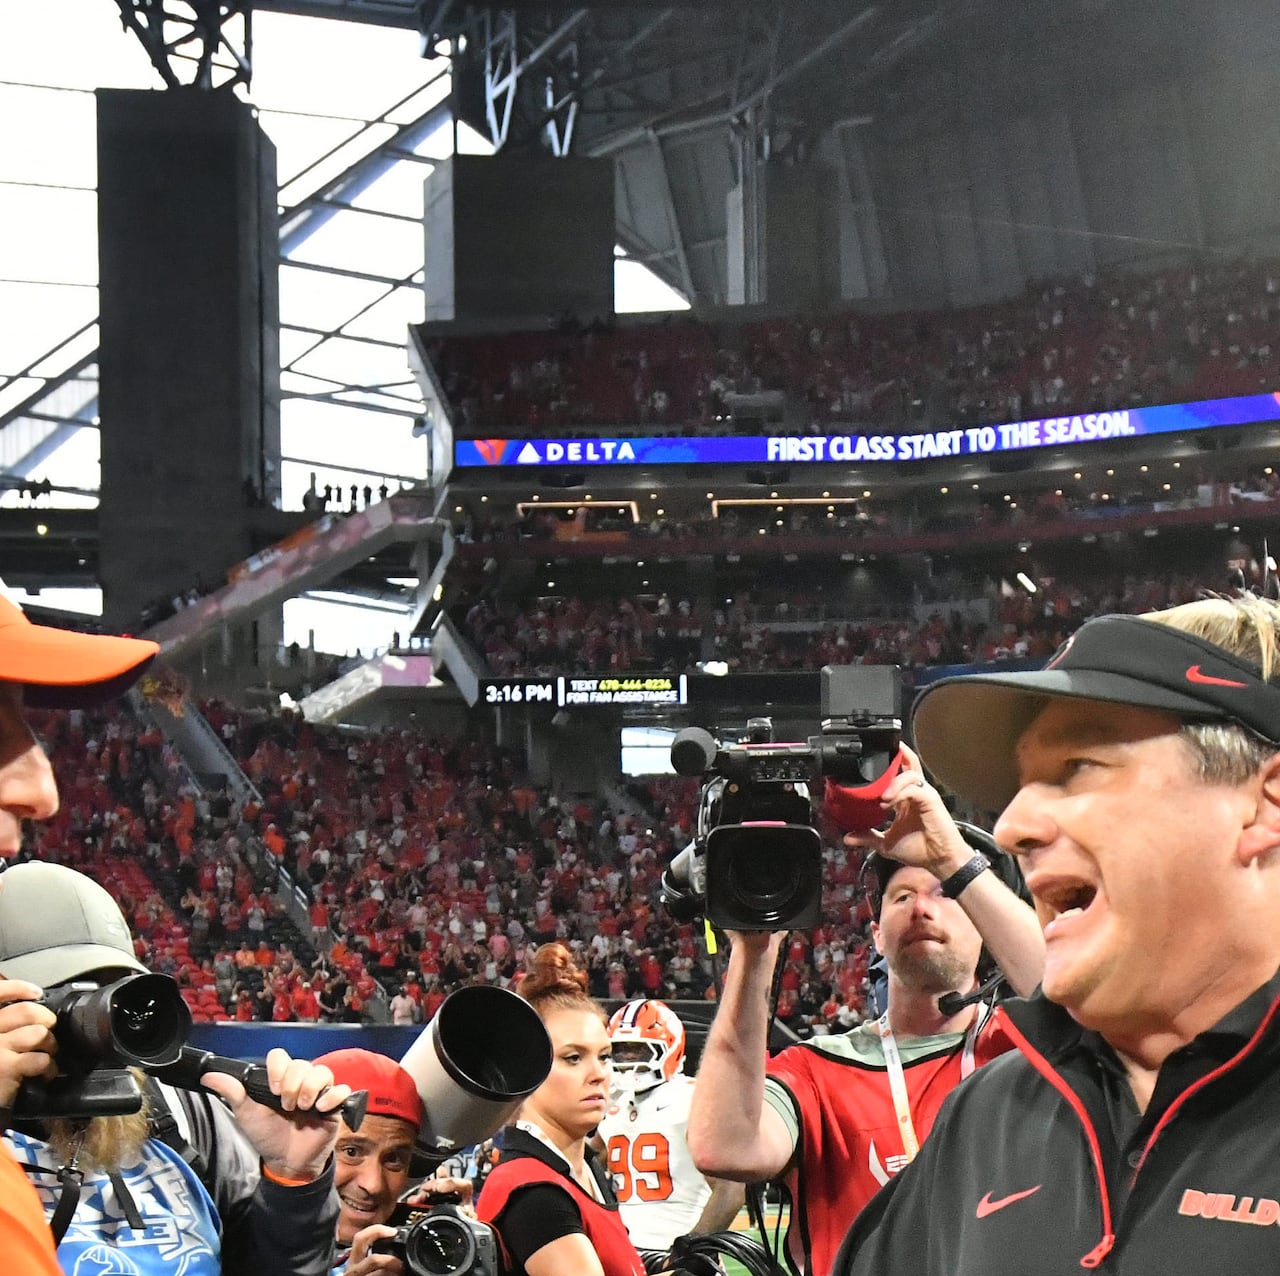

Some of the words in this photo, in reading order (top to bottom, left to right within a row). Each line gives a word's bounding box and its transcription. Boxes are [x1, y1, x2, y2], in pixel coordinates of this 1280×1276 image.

[767, 436, 828, 461] FIRST
[829, 436, 896, 461] CLASS
[897, 429, 964, 460] START
[965, 426, 997, 452] TO
[998, 420, 1041, 449] THE
[1044, 411, 1136, 445] SEASON.
[546, 441, 636, 461] DELTA
[486, 685, 522, 703] 3:16
[525, 684, 552, 702] PM
[570, 680, 599, 691] TEXT
[566, 692, 589, 704] FOR
[589, 691, 613, 703] FAN
[613, 690, 678, 703] ASSISTANCE
